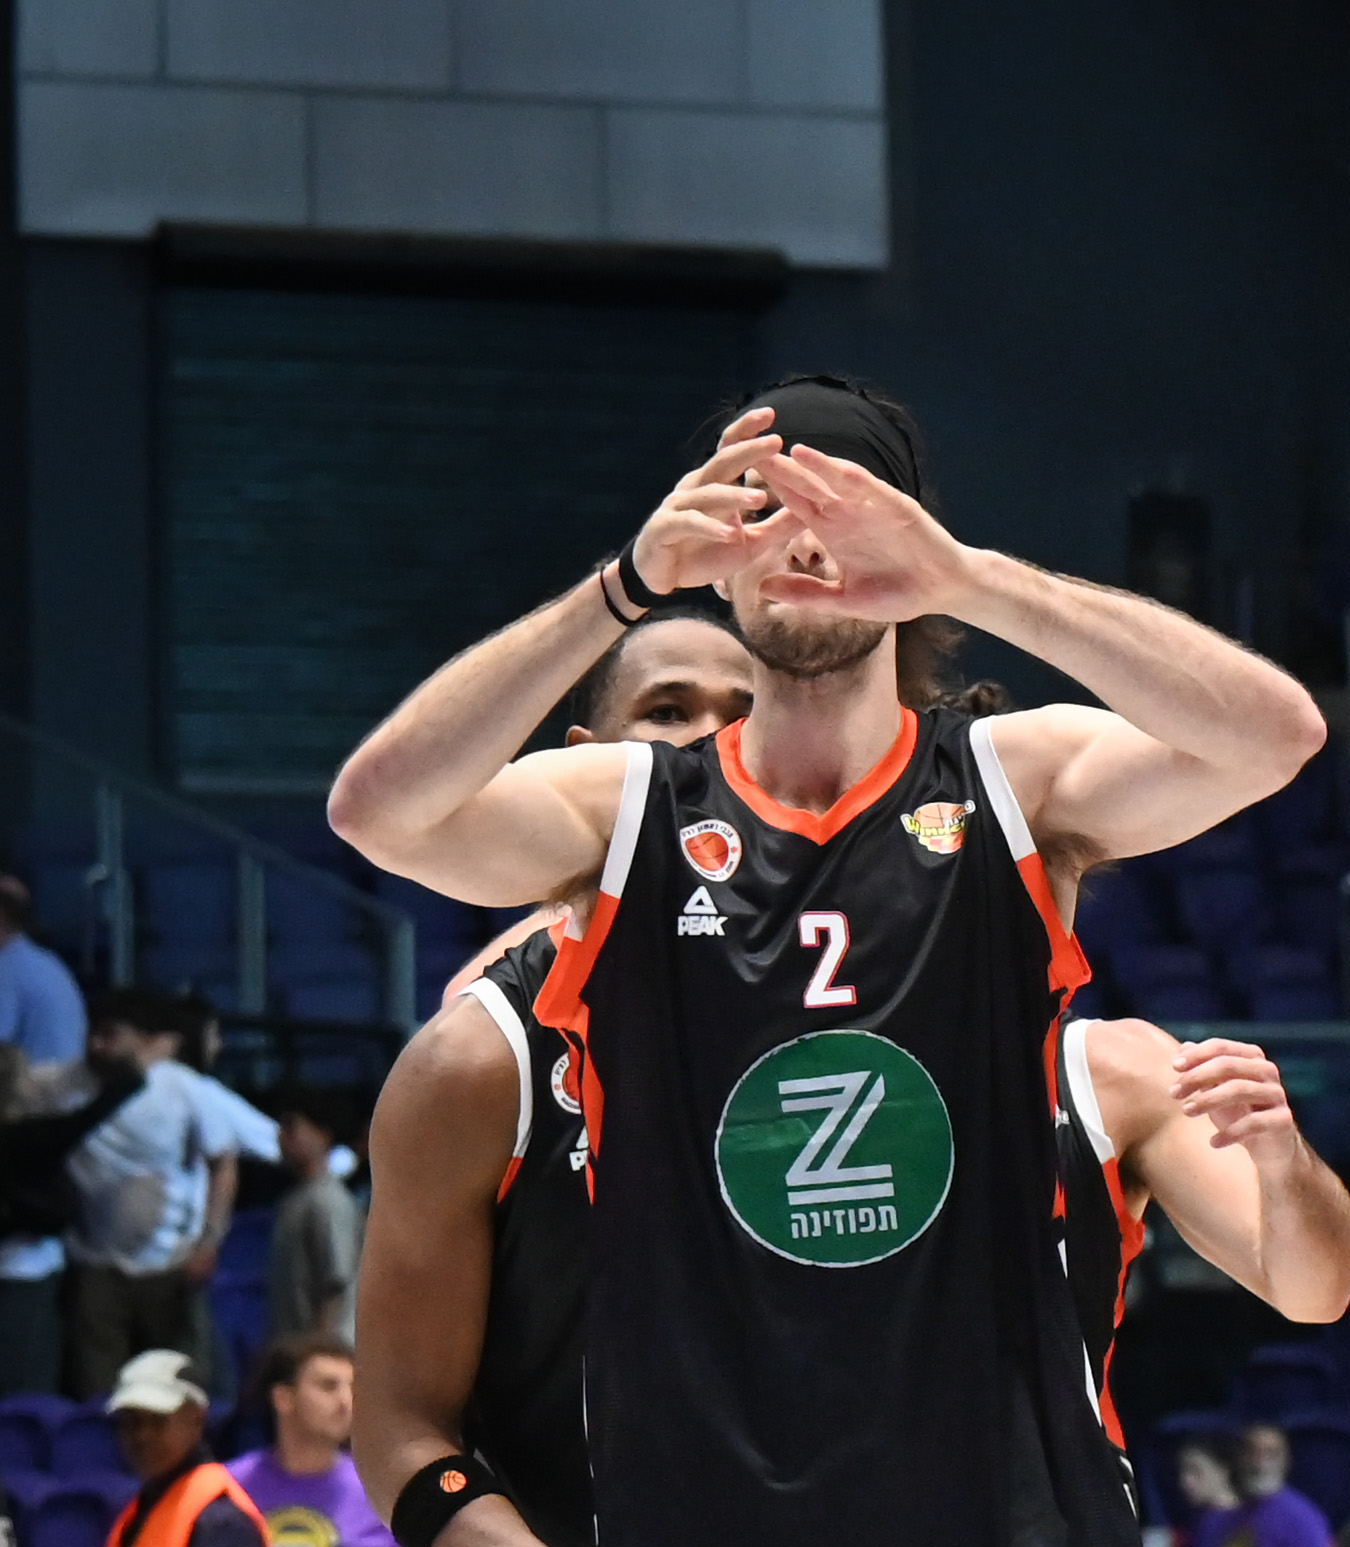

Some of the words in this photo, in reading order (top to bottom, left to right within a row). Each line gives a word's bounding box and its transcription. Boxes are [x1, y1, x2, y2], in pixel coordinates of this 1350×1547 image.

[677, 916, 728, 936] PEAK
[799, 911, 856, 1008] 2
[790, 1204, 899, 1239] תפוזינה
